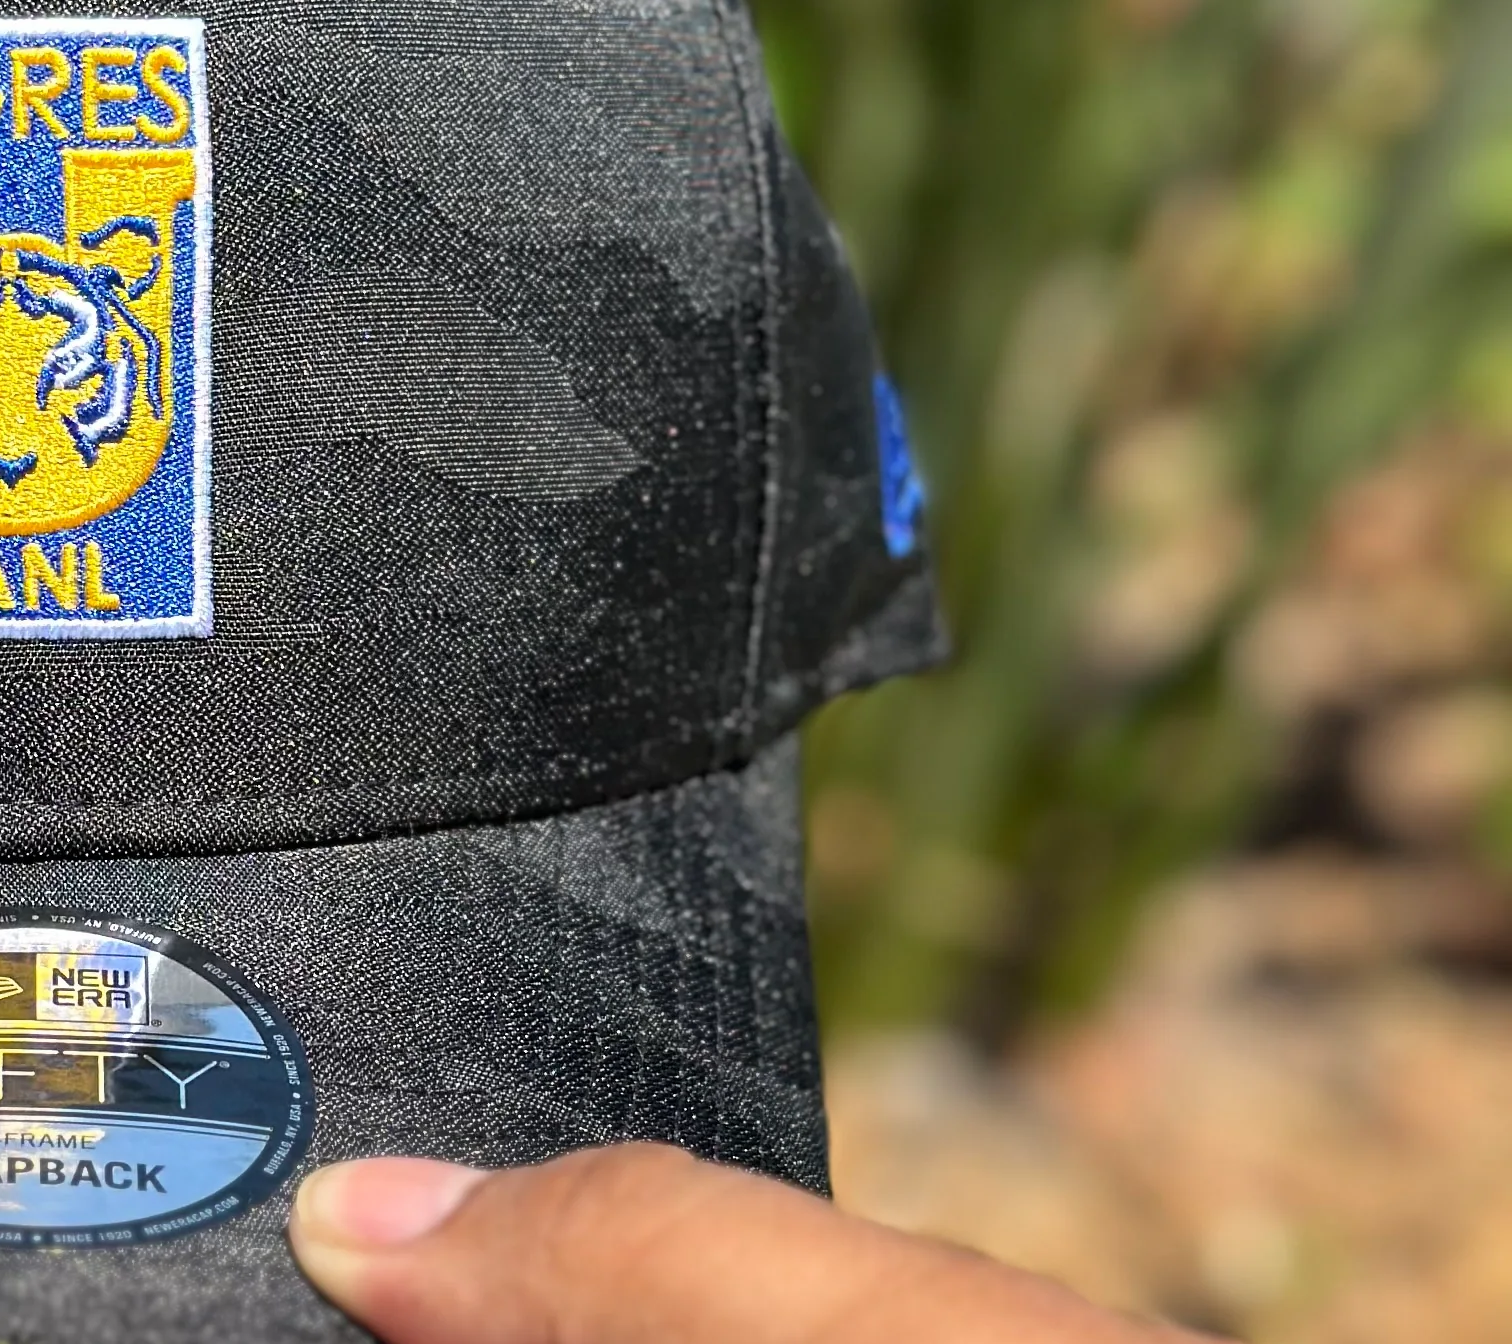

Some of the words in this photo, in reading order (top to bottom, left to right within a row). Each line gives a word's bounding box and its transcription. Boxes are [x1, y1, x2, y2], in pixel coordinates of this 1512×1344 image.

[51, 915, 76, 924] USA
[52, 967, 131, 989] NEW
[52, 989, 131, 1008] ERA
[202, 962, 276, 1027] NEWERACAP.COM
[273, 1034, 291, 1056] 1920
[284, 1060, 301, 1086] SINCE
[289, 1104, 301, 1121] USA
[143, 1195, 239, 1236] NEWERACAP.COM
[52, 1233, 93, 1243] SINCE
[99, 1230, 132, 1241] 1920
